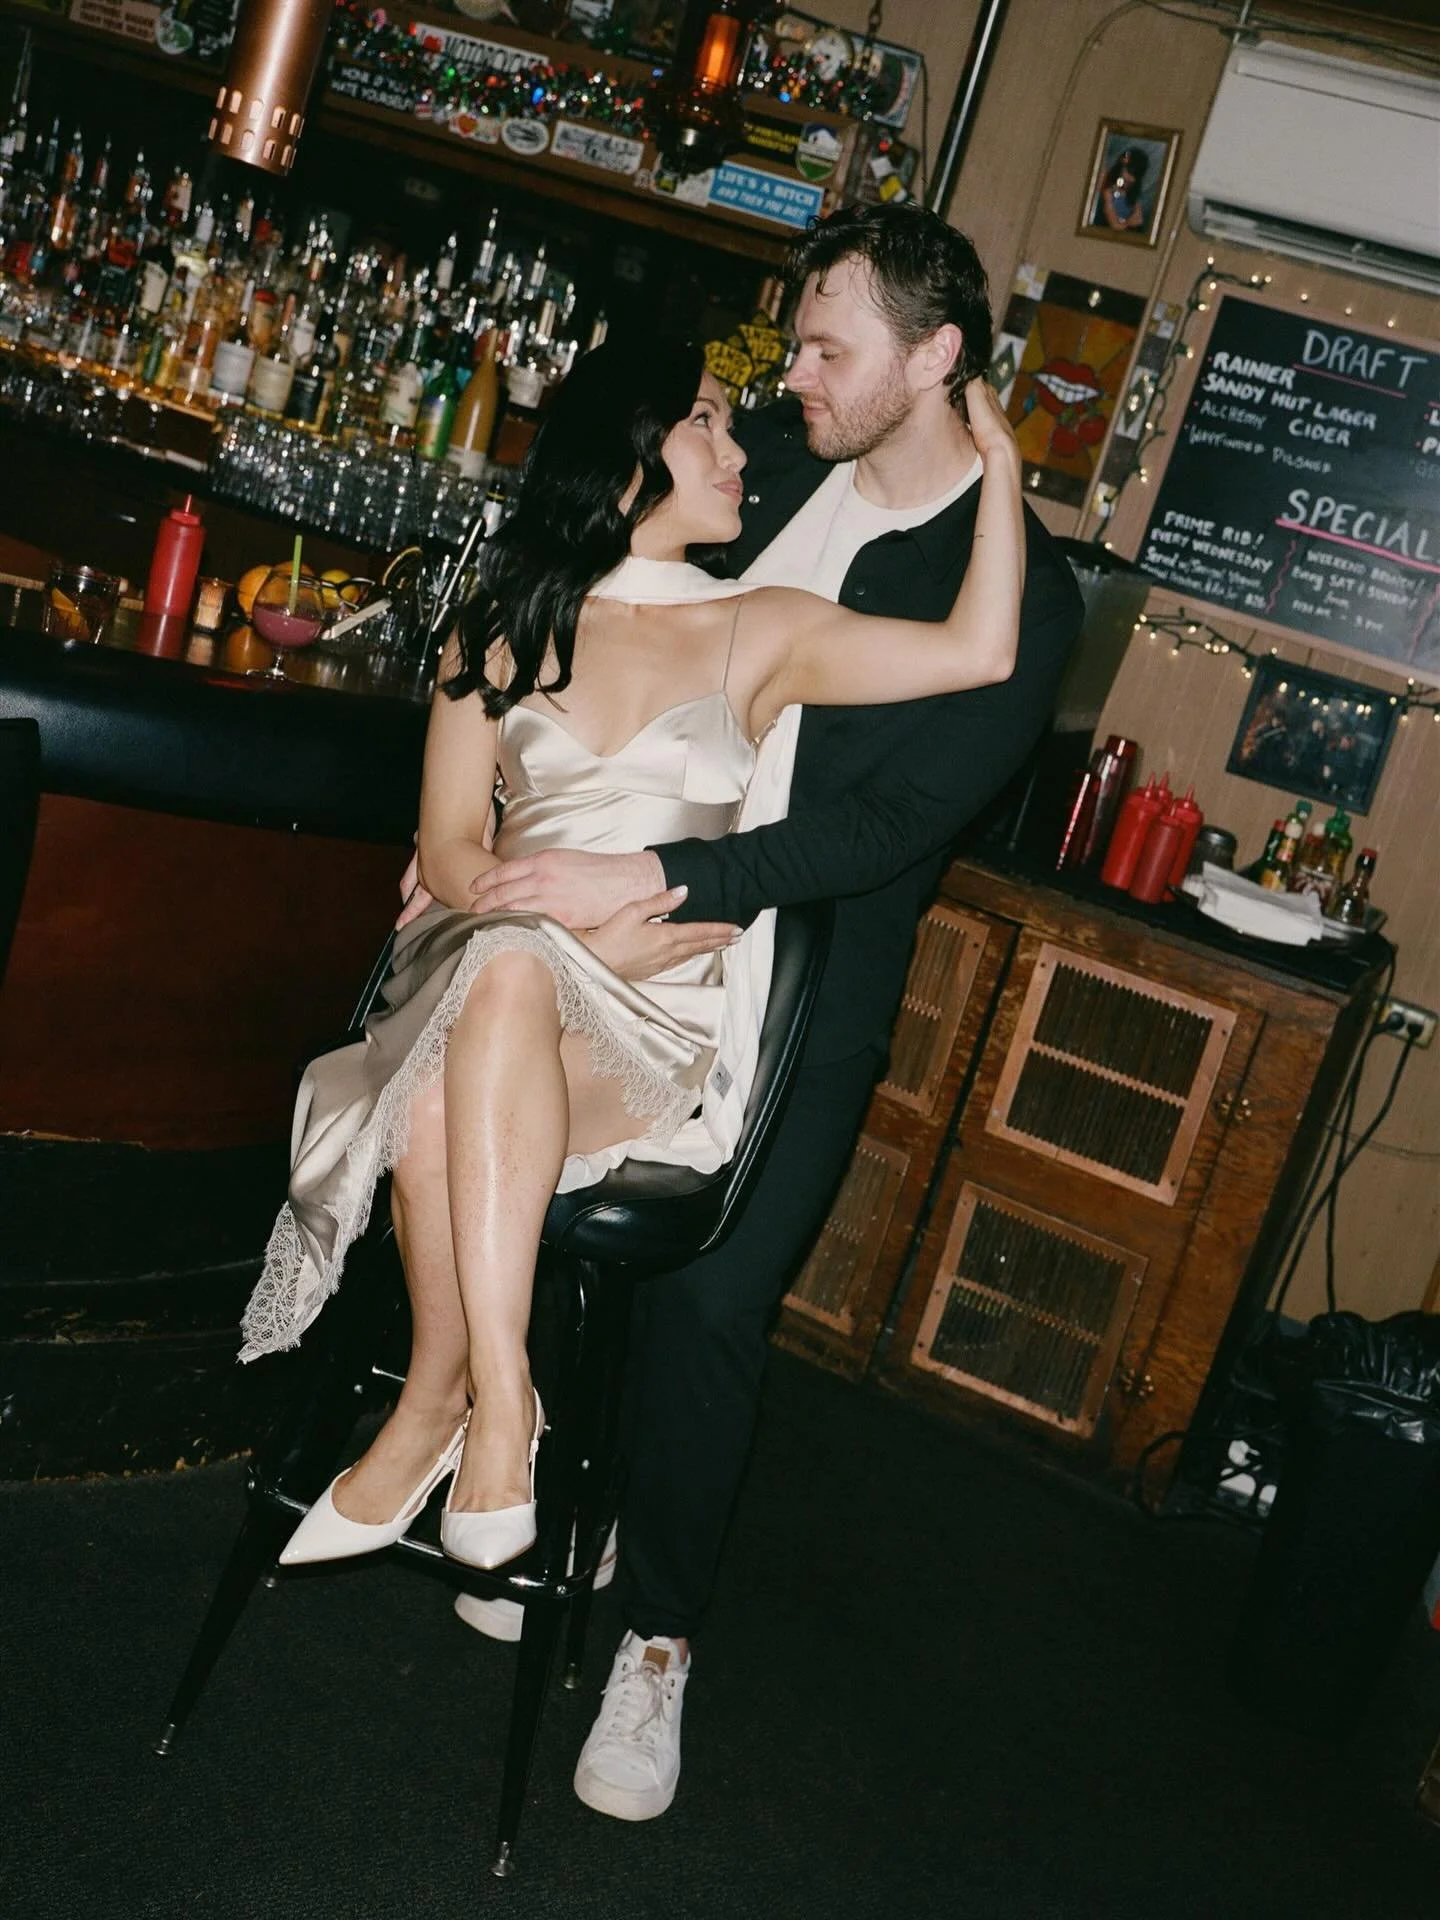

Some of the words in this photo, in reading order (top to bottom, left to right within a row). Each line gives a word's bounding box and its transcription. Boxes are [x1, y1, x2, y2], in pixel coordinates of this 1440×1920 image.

[760, 182, 771, 194] A
[774, 185, 816, 206] BITCH
[1213, 351, 1296, 390] RAINIER
[1302, 329, 1428, 389] DRAFT
[1200, 400, 1267, 430] ALCHEMY
[1202, 372, 1266, 404] SANDY
[1271, 391, 1311, 411] HUT
[1313, 401, 1377, 431] LAGER
[1288, 418, 1351, 448] CIDER
[1164, 510, 1216, 537] PRIME
[1222, 526, 1264, 550] RIB!
[1281, 489, 1440, 566] SPECIAL
[1150, 527, 1190, 548] EVERY
[1192, 539, 1273, 573] WEDNESDAY
[1307, 549, 1366, 574] WEEKEND
[1328, 574, 1356, 592] SAT
